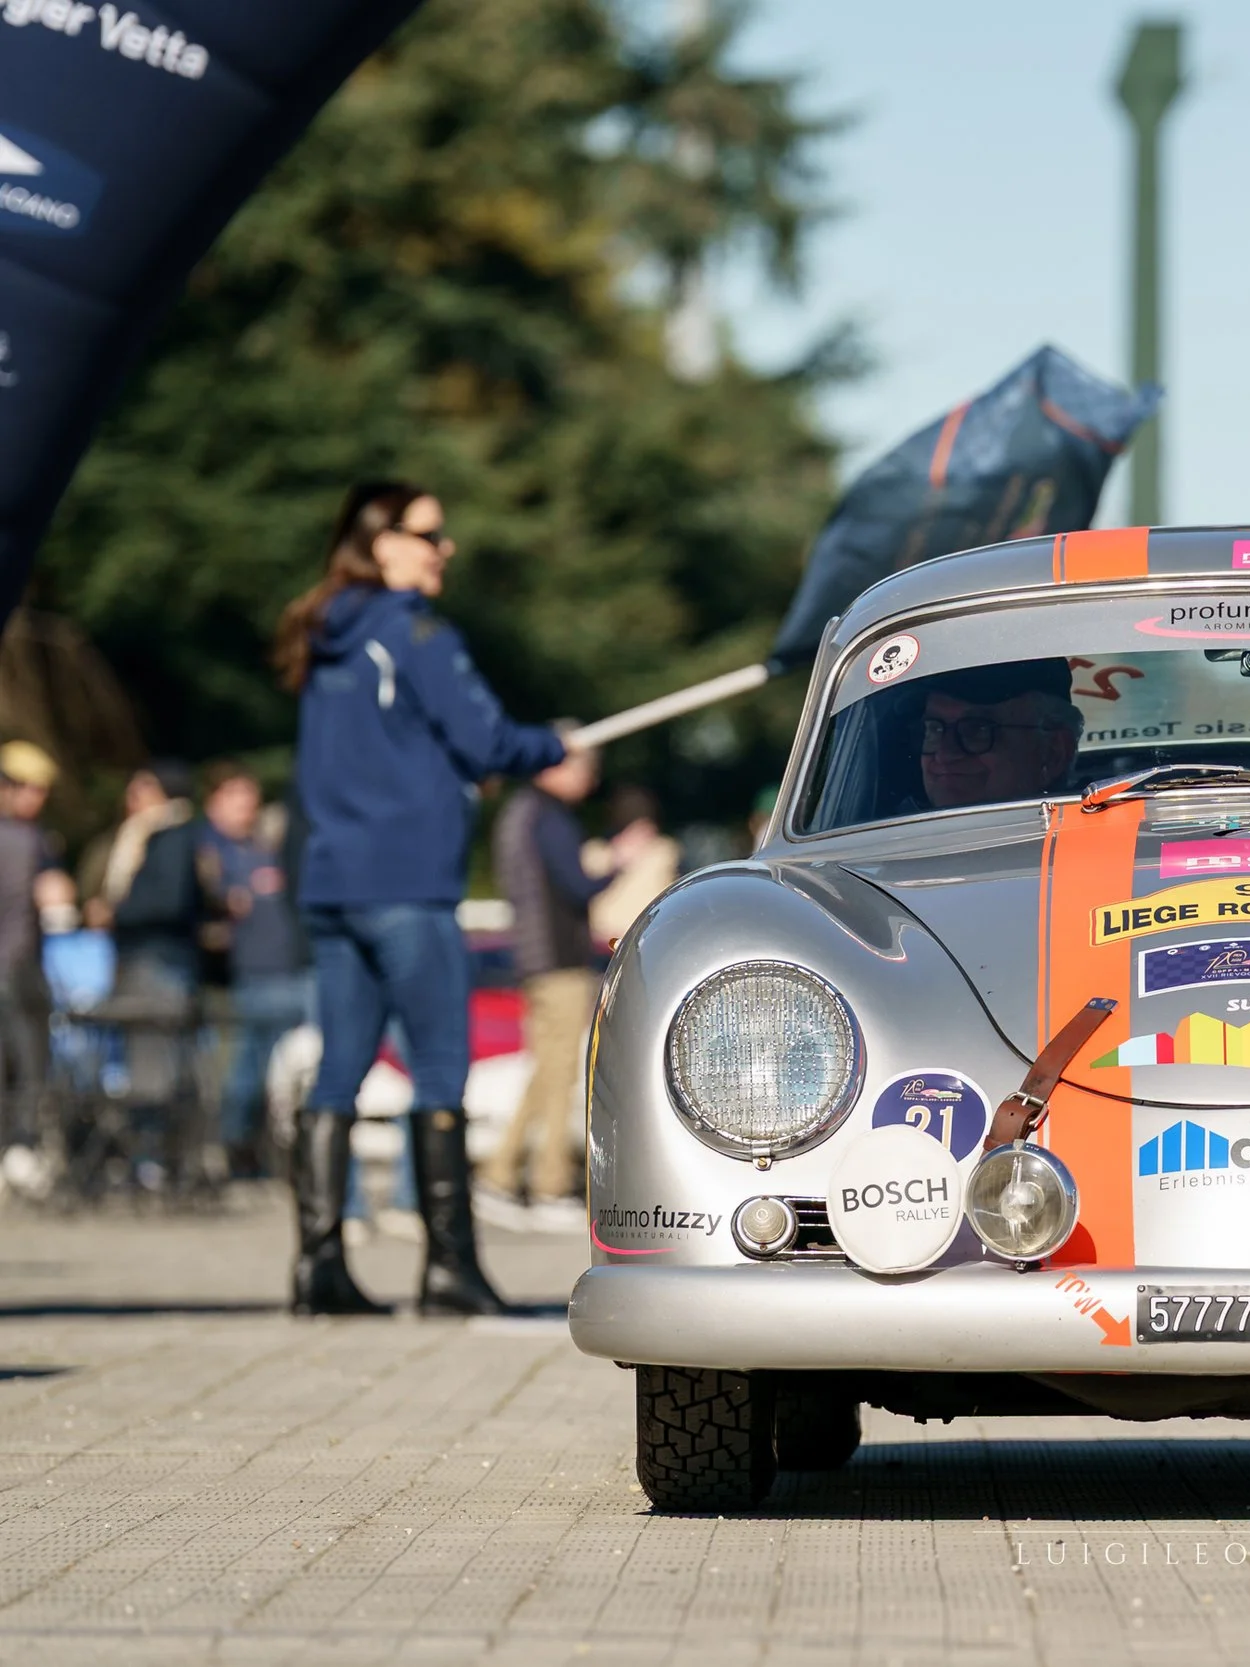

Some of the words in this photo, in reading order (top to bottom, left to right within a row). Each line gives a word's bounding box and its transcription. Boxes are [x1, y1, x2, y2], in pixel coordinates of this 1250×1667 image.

[98, 2, 210, 80] Vetta
[1204, 622, 1250, 630] AROMI
[1103, 904, 1199, 936] LIEGE
[1159, 1171, 1246, 1191] Erlebnis
[842, 1177, 948, 1212] BOSCH
[896, 1207, 950, 1222] RALLYE
